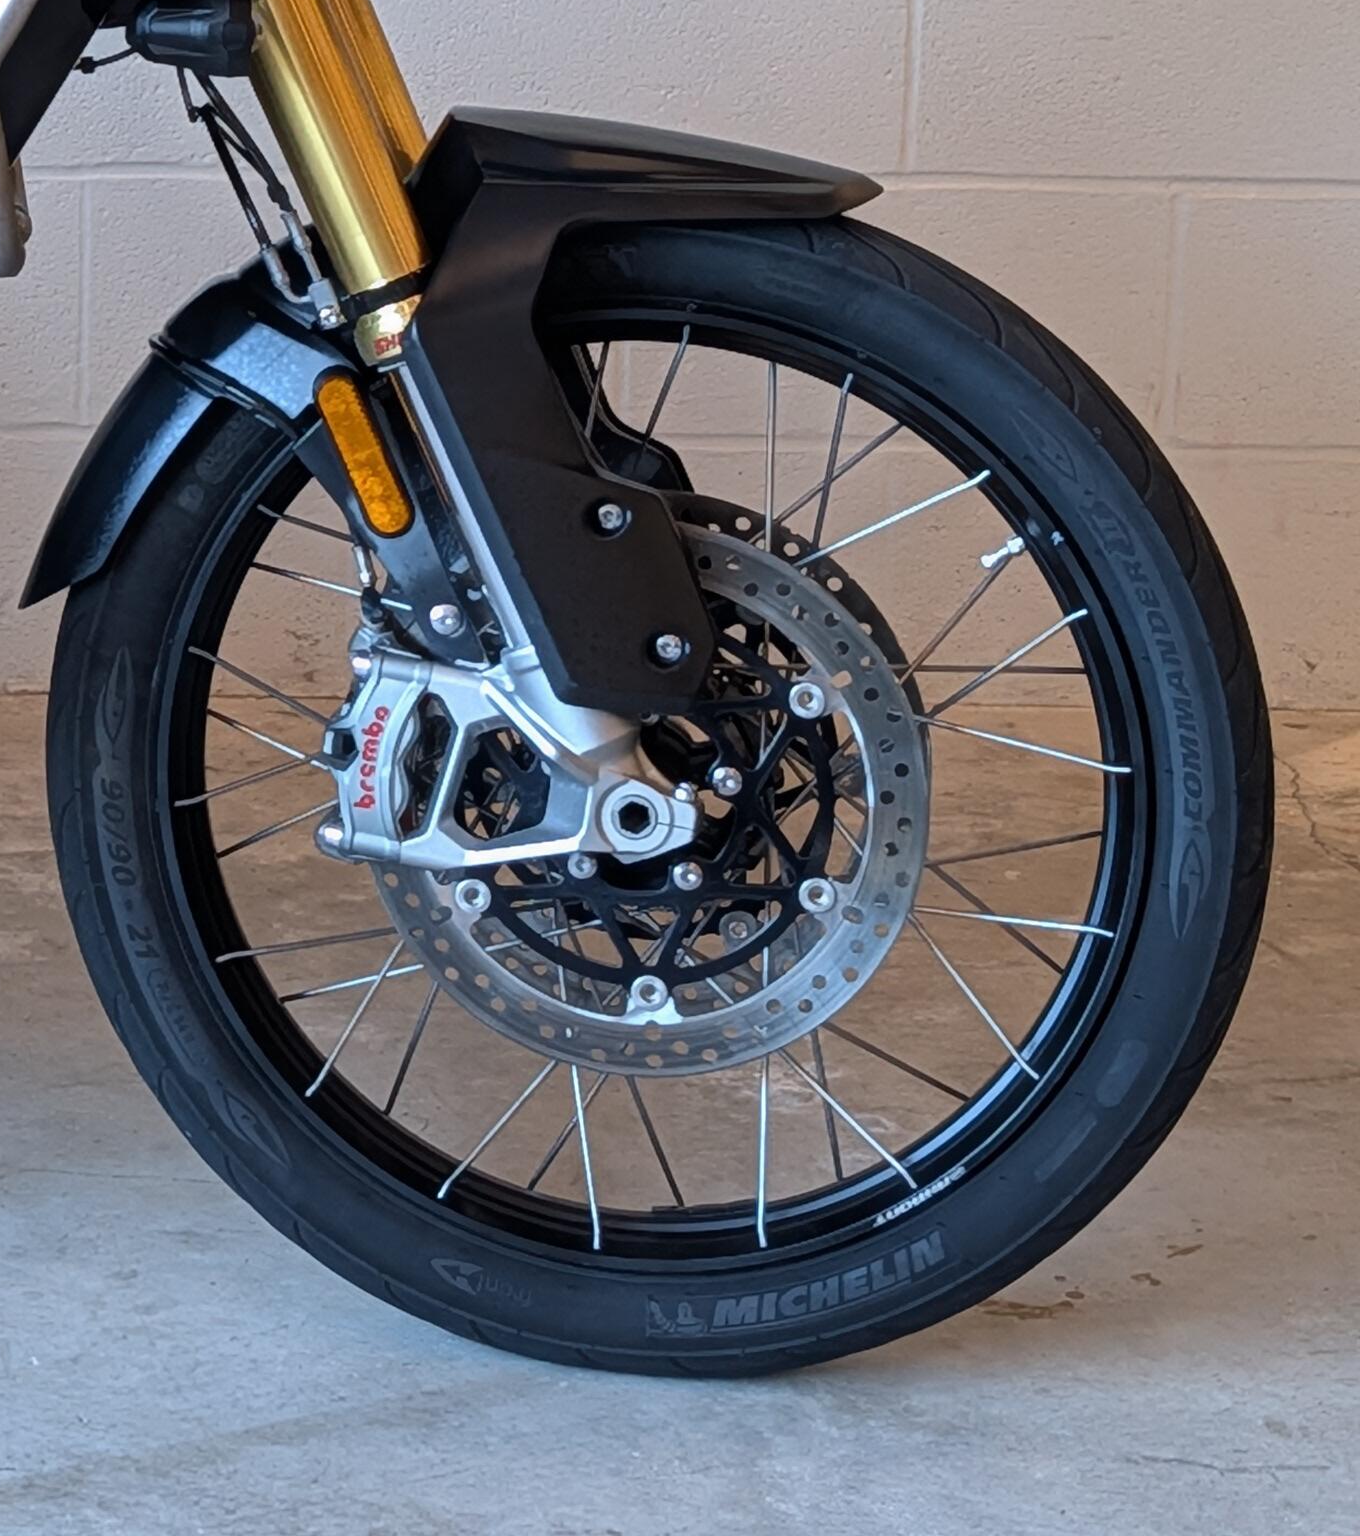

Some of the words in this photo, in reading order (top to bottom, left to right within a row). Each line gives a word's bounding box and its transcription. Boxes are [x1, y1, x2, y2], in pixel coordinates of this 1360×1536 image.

[353, 705, 391, 810] brembo
[1126, 560, 1204, 819] COMMANDER
[100, 777, 137, 887] 90/90
[125, 922, 161, 961] 21
[710, 1231, 948, 1330] MICHELIN
